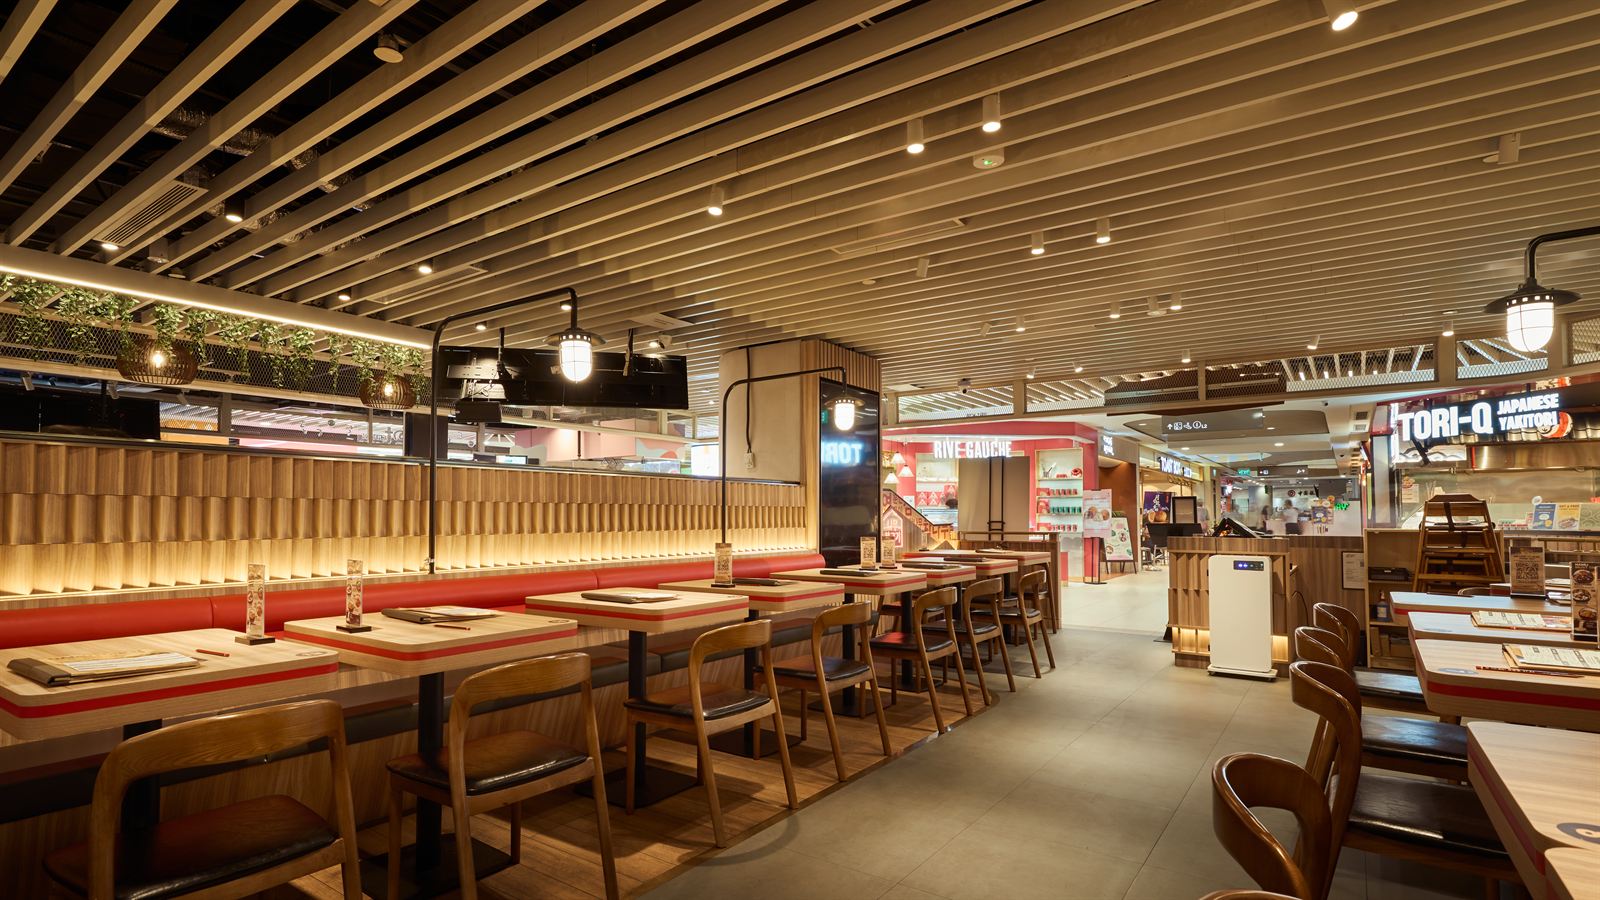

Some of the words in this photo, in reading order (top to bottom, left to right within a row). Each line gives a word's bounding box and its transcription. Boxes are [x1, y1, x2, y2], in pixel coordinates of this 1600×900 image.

[1497, 393, 1560, 415] JAPANESE
[1397, 402, 1494, 441] TORI-Q
[1499, 411, 1558, 431] YAKITORI
[933, 440, 962, 459] RIVE
[965, 440, 1012, 459] GAUCHE
